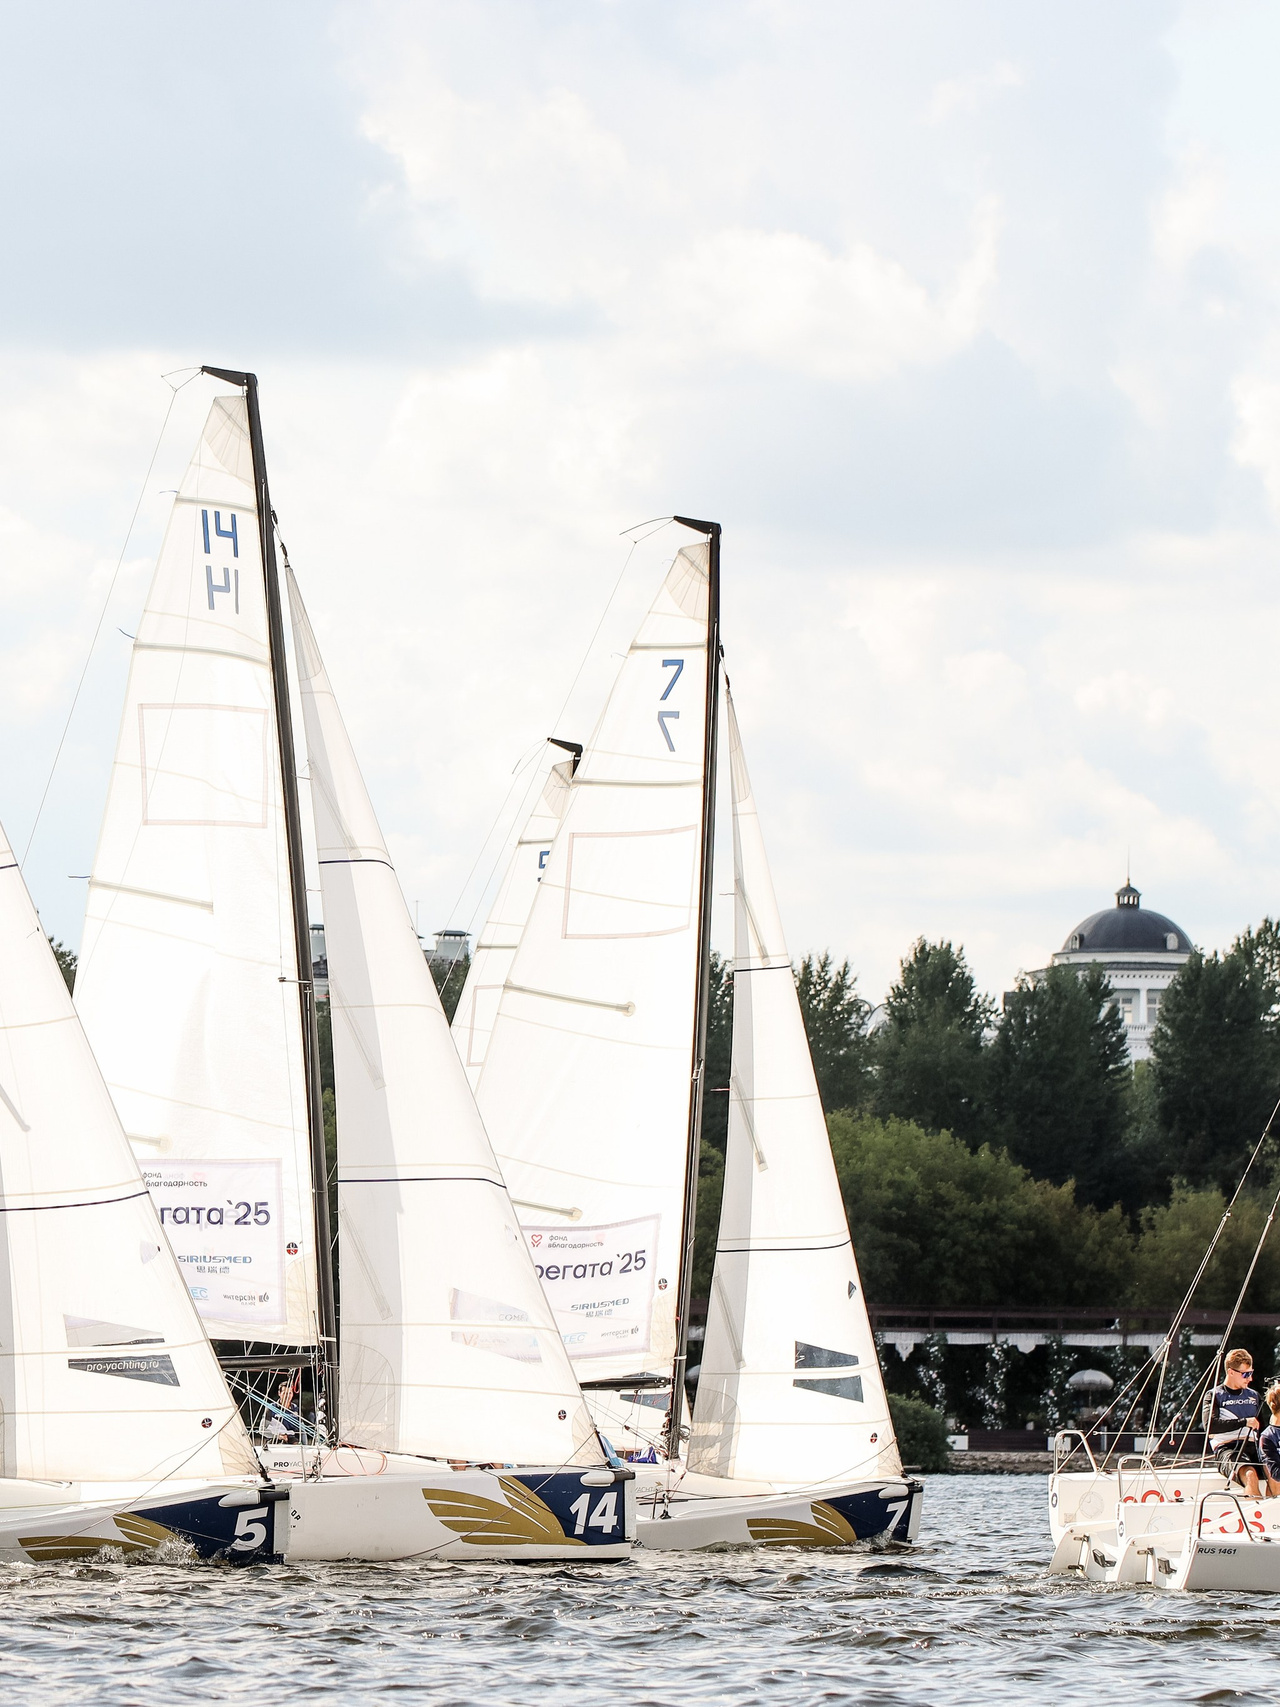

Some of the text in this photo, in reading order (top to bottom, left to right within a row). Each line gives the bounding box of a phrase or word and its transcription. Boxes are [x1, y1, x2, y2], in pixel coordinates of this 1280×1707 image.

[201, 509, 239, 558] 14
[659, 659, 684, 701] 7
[145, 1180, 208, 1188] благодарность
[177, 1255, 252, 1264] SIRIUSMED
[570, 1297, 630, 1311] SIRIUSMED
[86, 1360, 160, 1373] pro-yachting.ru
[230, 1506, 269, 1551] 5
[569, 1491, 618, 1535] 14
[885, 1499, 910, 1537] 7
